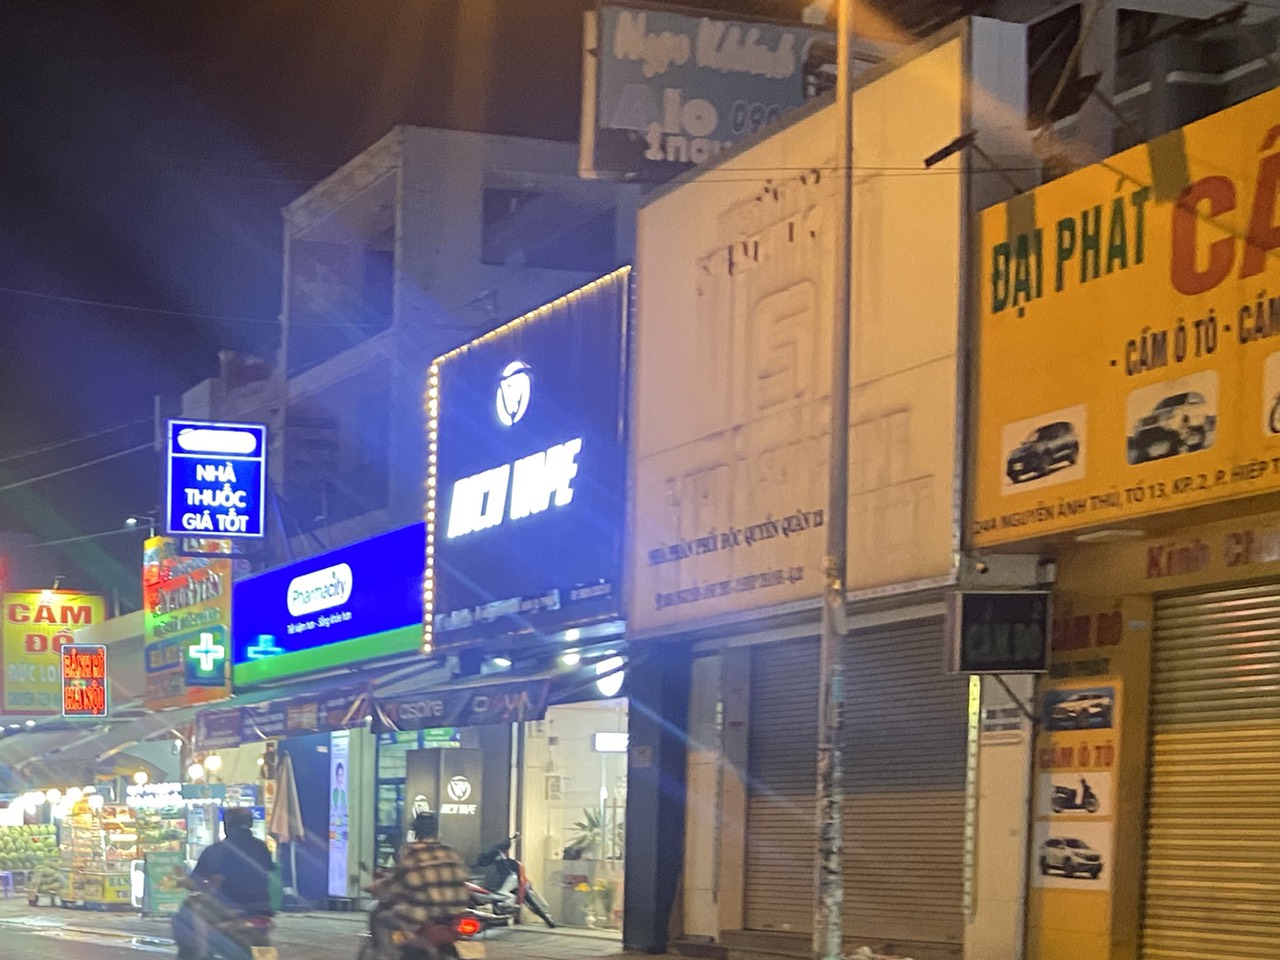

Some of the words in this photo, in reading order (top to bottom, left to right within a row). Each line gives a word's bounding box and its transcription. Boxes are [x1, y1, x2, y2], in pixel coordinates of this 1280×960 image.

[992, 226, 1043, 318] ĐẠI
[1055, 175, 1153, 293] PHÁT
[196, 462, 236, 483] NHÀ
[185, 483, 247, 508] THUỐC
[182, 510, 213, 531] GIÁ
[216, 508, 249, 532] TỐT
